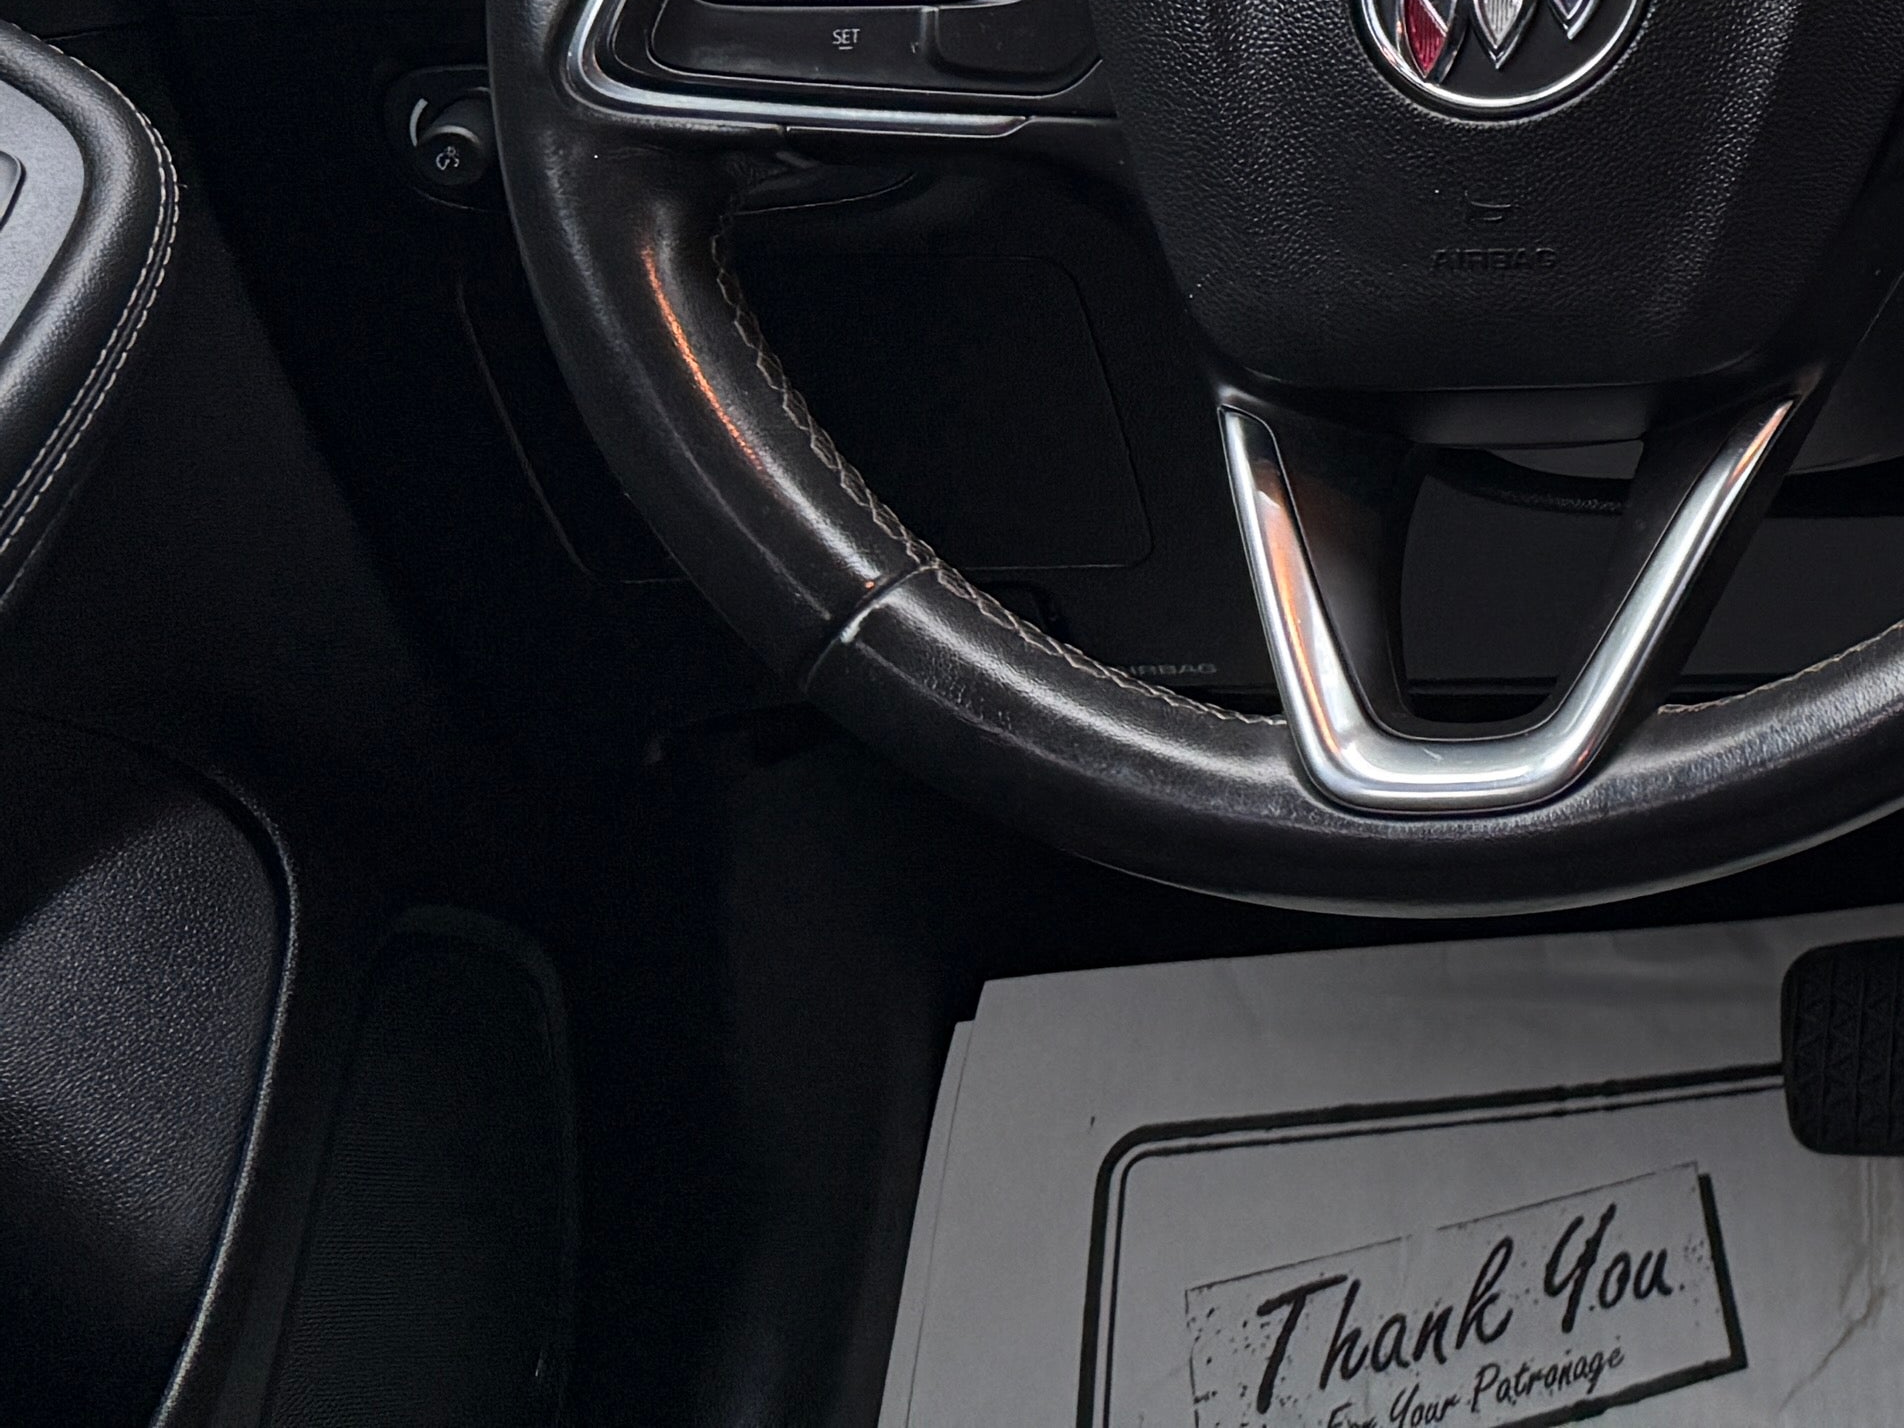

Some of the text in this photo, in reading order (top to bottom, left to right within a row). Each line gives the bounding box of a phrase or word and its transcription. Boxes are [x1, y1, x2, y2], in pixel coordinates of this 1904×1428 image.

[832, 28, 861, 45] SET
[1256, 1203, 1673, 1414] Thank You
[1388, 1386, 1461, 1428] Your
[1472, 1342, 1626, 1414] Patronage
